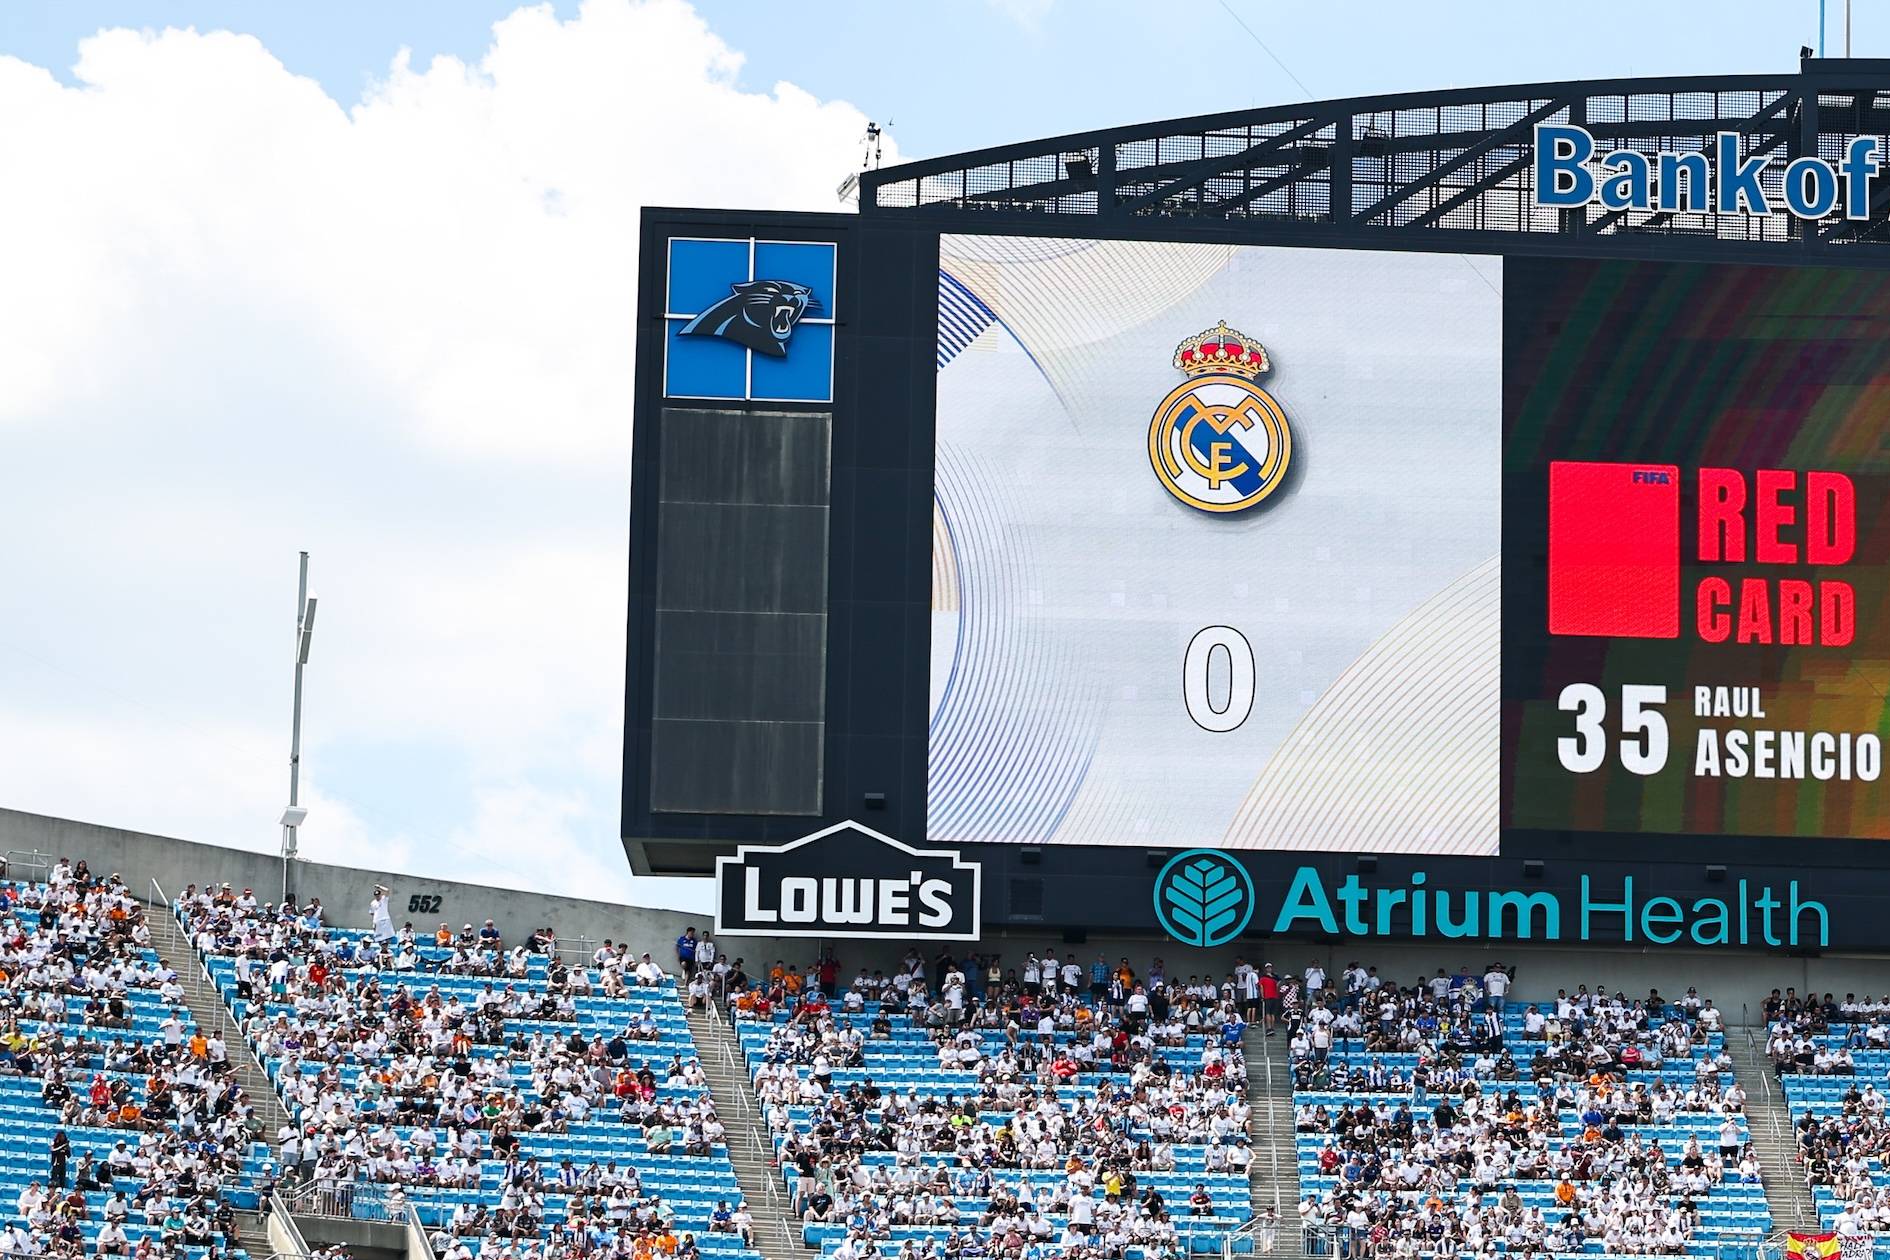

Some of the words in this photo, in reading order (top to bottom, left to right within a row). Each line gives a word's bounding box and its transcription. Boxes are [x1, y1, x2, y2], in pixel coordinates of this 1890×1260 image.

[1533, 123, 1771, 217] Bank
[1772, 134, 1883, 223] of
[1633, 471, 1670, 485] FIFA
[1697, 467, 1857, 566] RED
[1696, 576, 1856, 648] CARD
[1183, 625, 1256, 733] 0
[1694, 685, 1766, 719] RAUL
[1557, 683, 1669, 775] 35
[1694, 728, 1882, 782] ASENCIO
[408, 894, 443, 914] 552
[744, 866, 953, 928] LOWE'S
[1273, 866, 1560, 940] Atrium
[1581, 873, 1830, 947] Health
